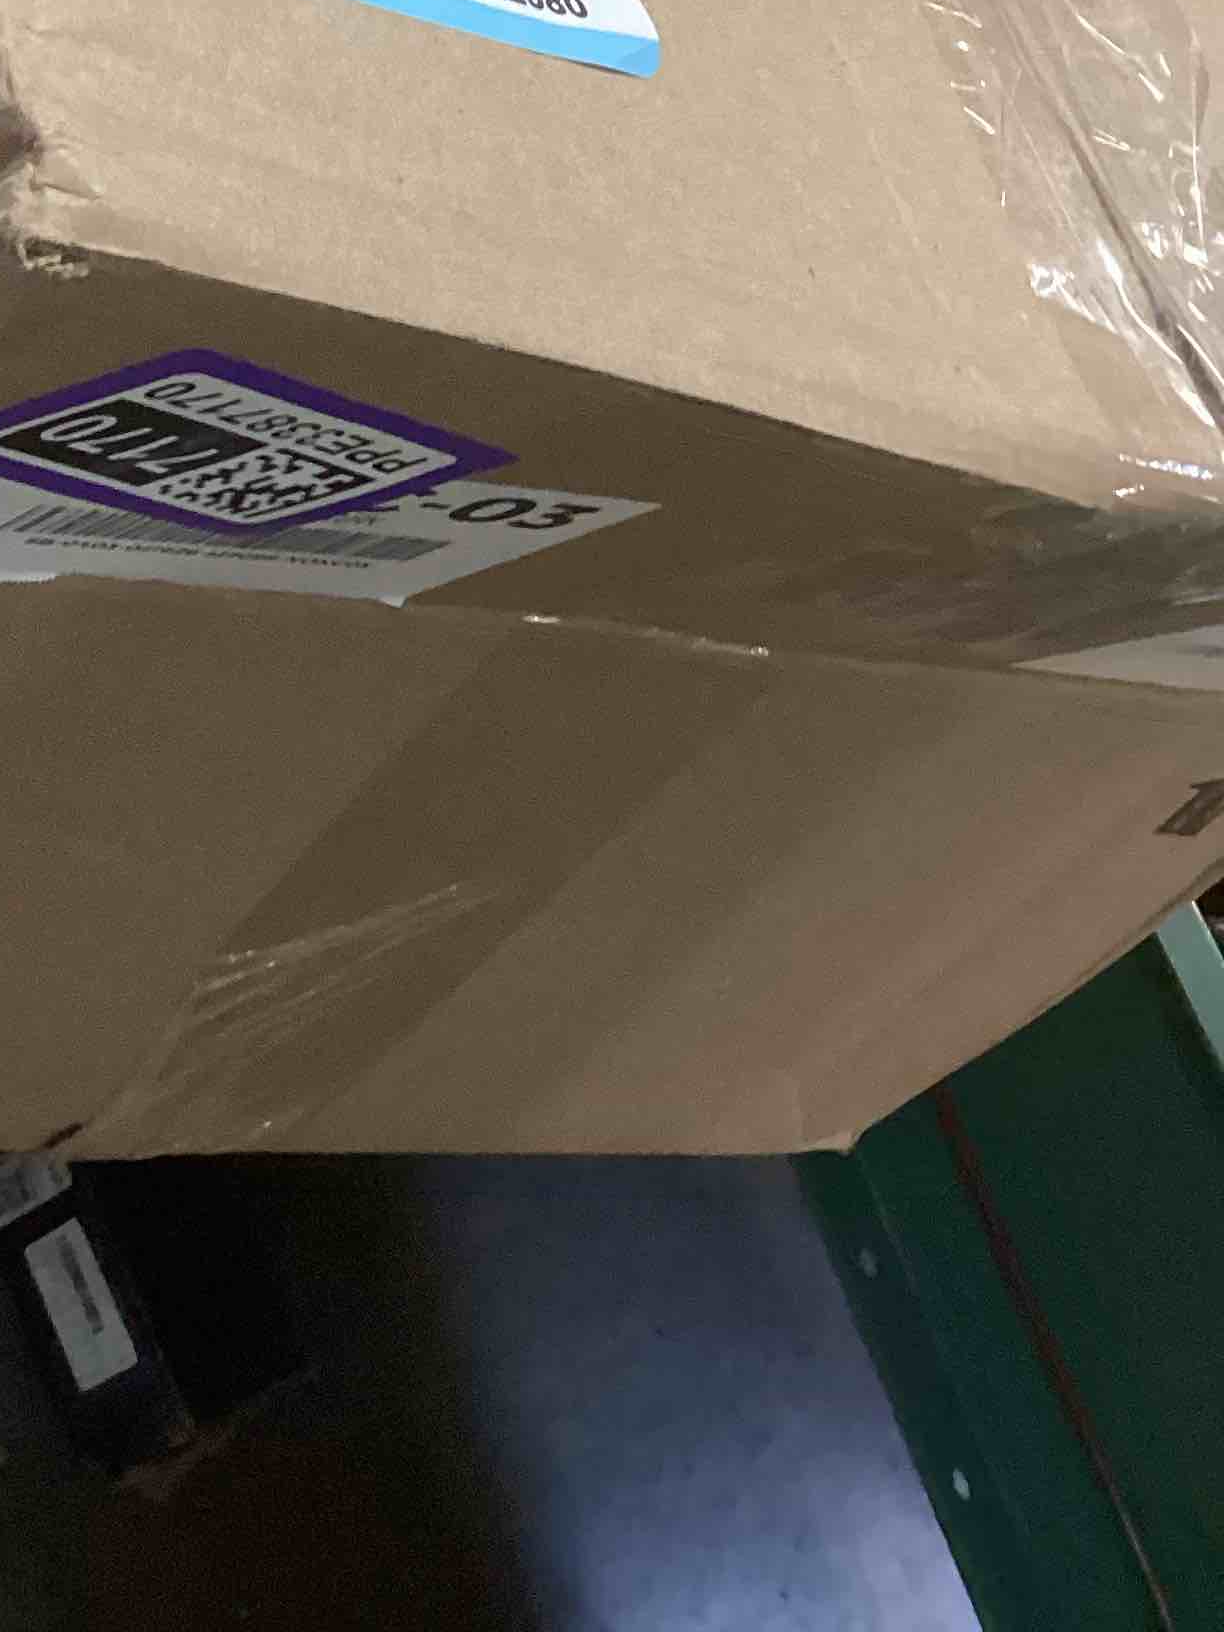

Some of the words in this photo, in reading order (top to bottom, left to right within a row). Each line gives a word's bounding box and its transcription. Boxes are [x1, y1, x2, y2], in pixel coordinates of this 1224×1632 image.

[39, 414, 219, 474] 7170
[144, 380, 428, 474] PPE3387170
[374, 488, 603, 529] -03
